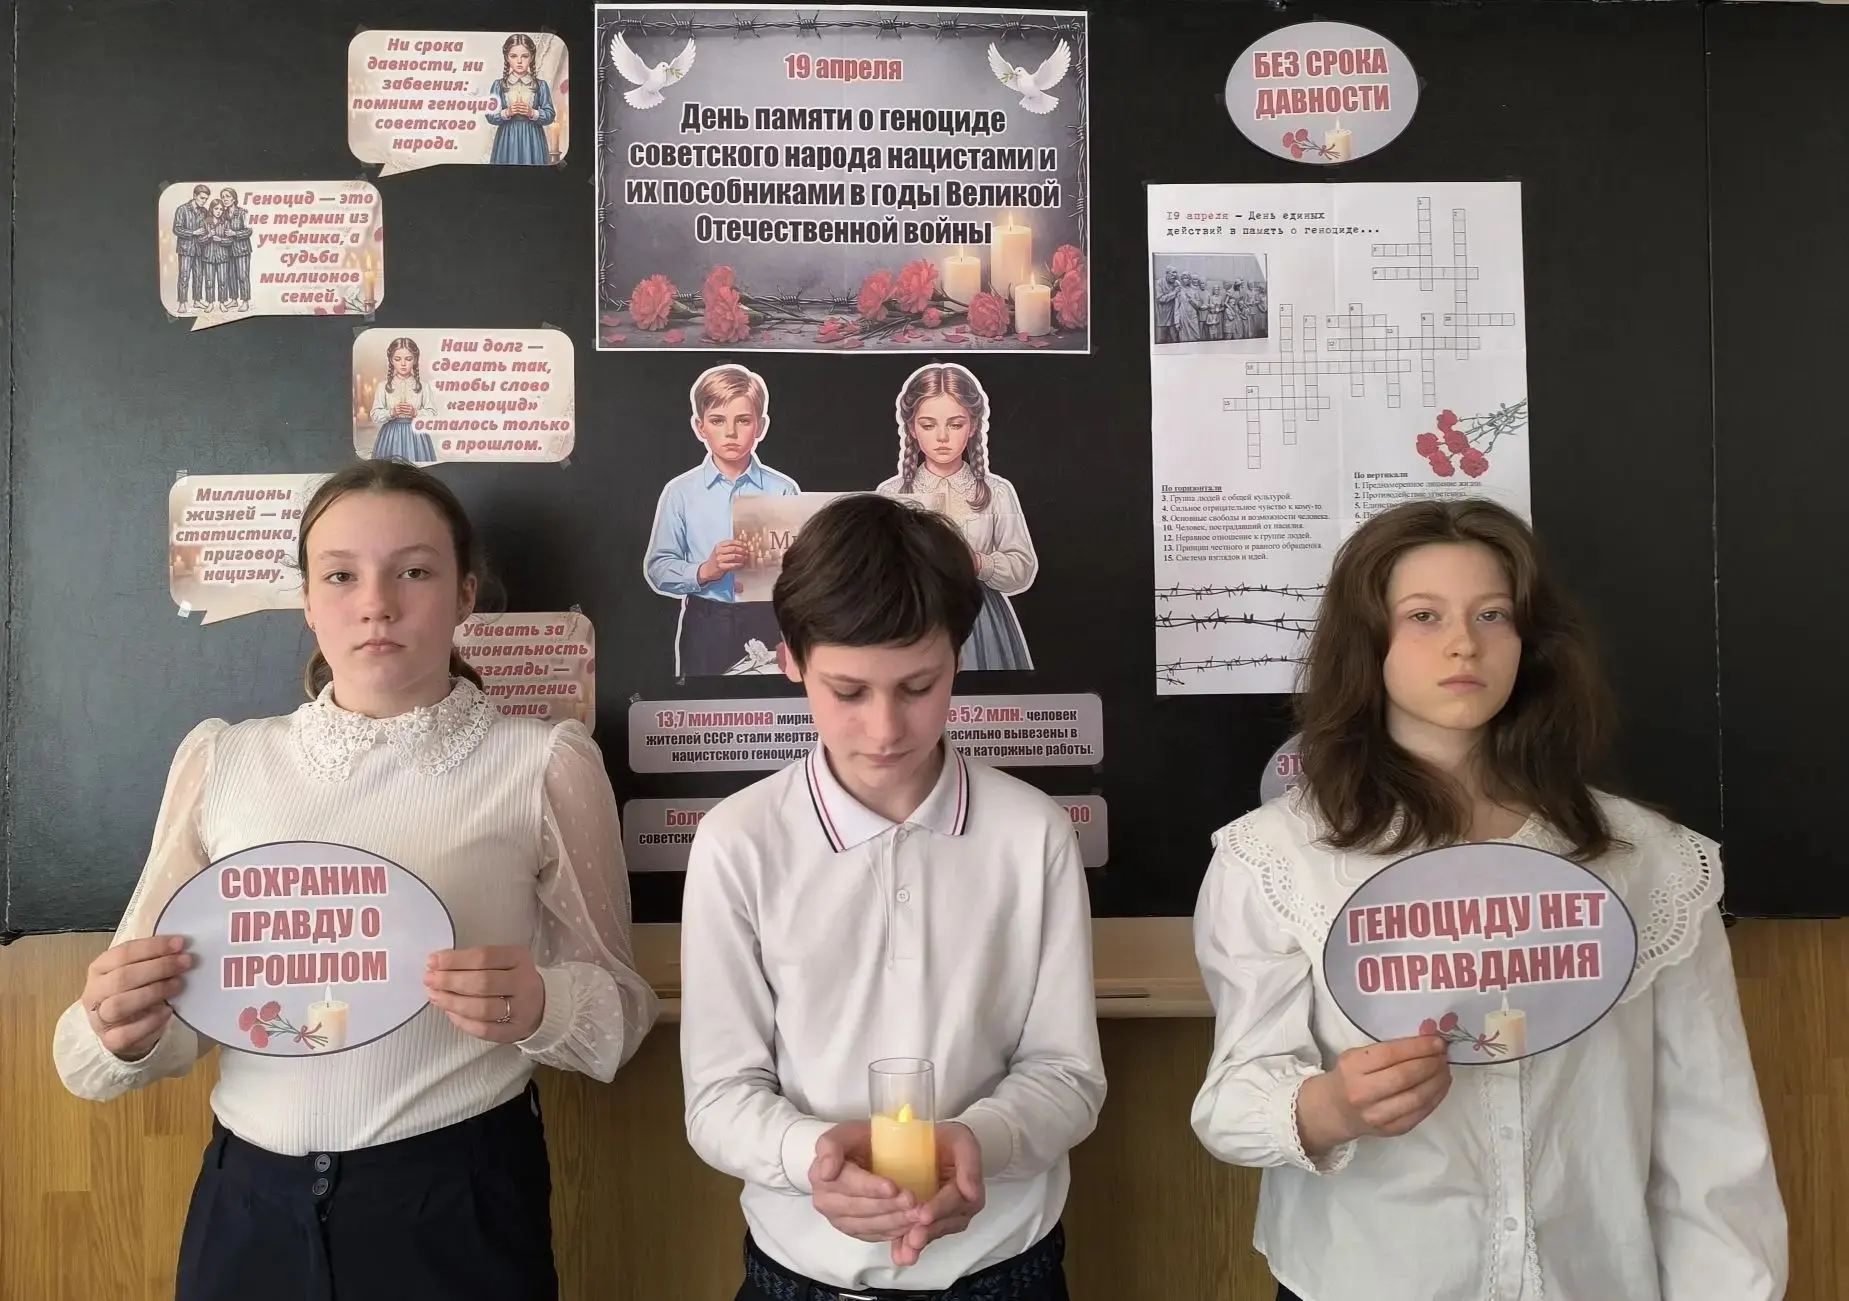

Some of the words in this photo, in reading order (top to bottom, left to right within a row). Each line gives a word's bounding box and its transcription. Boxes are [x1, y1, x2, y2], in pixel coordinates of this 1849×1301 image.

[388, 38, 410, 53] Ни
[414, 39, 464, 55] срока
[368, 57, 457, 74] давности,
[462, 60, 484, 73] ни
[784, 54, 810, 79] 19
[816, 57, 902, 81] апреля
[1254, 51, 1300, 78] БЕЗ
[1306, 48, 1388, 76] СРОКА
[382, 77, 469, 92] забвения:
[352, 97, 423, 112] помним
[427, 96, 498, 115] геноцид
[1255, 85, 1390, 119] ДАВНОСТИ
[375, 117, 476, 131] советского
[681, 103, 749, 133] День
[755, 107, 852, 131] памяти
[859, 109, 873, 131] о
[879, 109, 1006, 135] геноциде
[392, 136, 459, 152] народа.
[629, 143, 779, 168] советского
[784, 145, 882, 170] народа
[887, 146, 1034, 172] нацистами
[1039, 148, 1056, 170] и
[243, 191, 314, 209] Геноцид
[339, 193, 373, 205] это
[626, 181, 657, 203] их
[662, 179, 846, 205] пособниками
[850, 183, 866, 205] в
[870, 183, 940, 208] годы
[945, 180, 1060, 207] Великой
[248, 212, 269, 225] не
[273, 211, 345, 227] термин
[349, 212, 369, 224] из
[1186, 212, 1229, 221] апреля
[1248, 211, 1276, 221] День
[1282, 212, 1325, 221] единых
[258, 230, 345, 248] учебника,
[350, 232, 360, 244] а
[696, 216, 899, 243] Отечественной
[903, 220, 992, 245] войны
[1166, 226, 1222, 236] действий
[1242, 227, 1284, 235] память
[1290, 227, 1297, 235] о
[280, 250, 339, 267] судьба
[259, 270, 360, 284] миллионов
[280, 287, 339, 304] семей.
[441, 339, 479, 352] Наш
[482, 339, 523, 355] долг
[432, 358, 507, 374] сделать
[511, 359, 552, 376] так,
[435, 377, 496, 393] чтобы
[499, 378, 550, 392] слово
[446, 397, 538, 415] «геноцид»
[415, 418, 498, 432] осталось
[502, 417, 570, 432] только
[442, 438, 452, 451] в
[455, 437, 542, 453] прошлом.
[196, 487, 292, 502] Миллионы
[1161, 485, 1173, 493] По
[185, 506, 256, 522] жизней
[281, 508, 301, 520] не
[175, 528, 297, 544] статистика,
[203, 547, 285, 564] приговор
[203, 567, 285, 584] нацизму.
[463, 623, 540, 637] Убивать
[544, 625, 565, 636] за
[459, 644, 588, 659] циональность
[484, 683, 577, 699] ступление
[498, 703, 548, 716] отив
[960, 706, 983, 723] 5,2
[986, 707, 1024, 722] млн.
[1027, 710, 1077, 722] человек
[655, 711, 685, 729] 13,7
[688, 711, 774, 727] миллиона
[646, 732, 701, 746] жителей
[703, 730, 734, 745] СССР
[736, 732, 772, 744] стали
[774, 731, 819, 743] жертва
[948, 729, 1001, 740] асильно
[1004, 728, 1067, 739] вывезены
[1070, 728, 1078, 738] в
[672, 748, 749, 762] нацистского
[750, 747, 809, 761] геноцида
[973, 745, 1043, 757] каторжные
[1045, 743, 1094, 757] работы.
[639, 834, 695, 844] советски
[220, 866, 387, 898] СОХРАНИМ
[230, 908, 354, 943] ПРАВДУ
[361, 907, 381, 938] О
[1349, 895, 1531, 943] ГЕНОЦИДУ
[1539, 892, 1606, 929] НЕТ
[222, 951, 387, 988] ПРОШЛОМ
[1358, 943, 1600, 993] ОПРАВДАНИЯ
